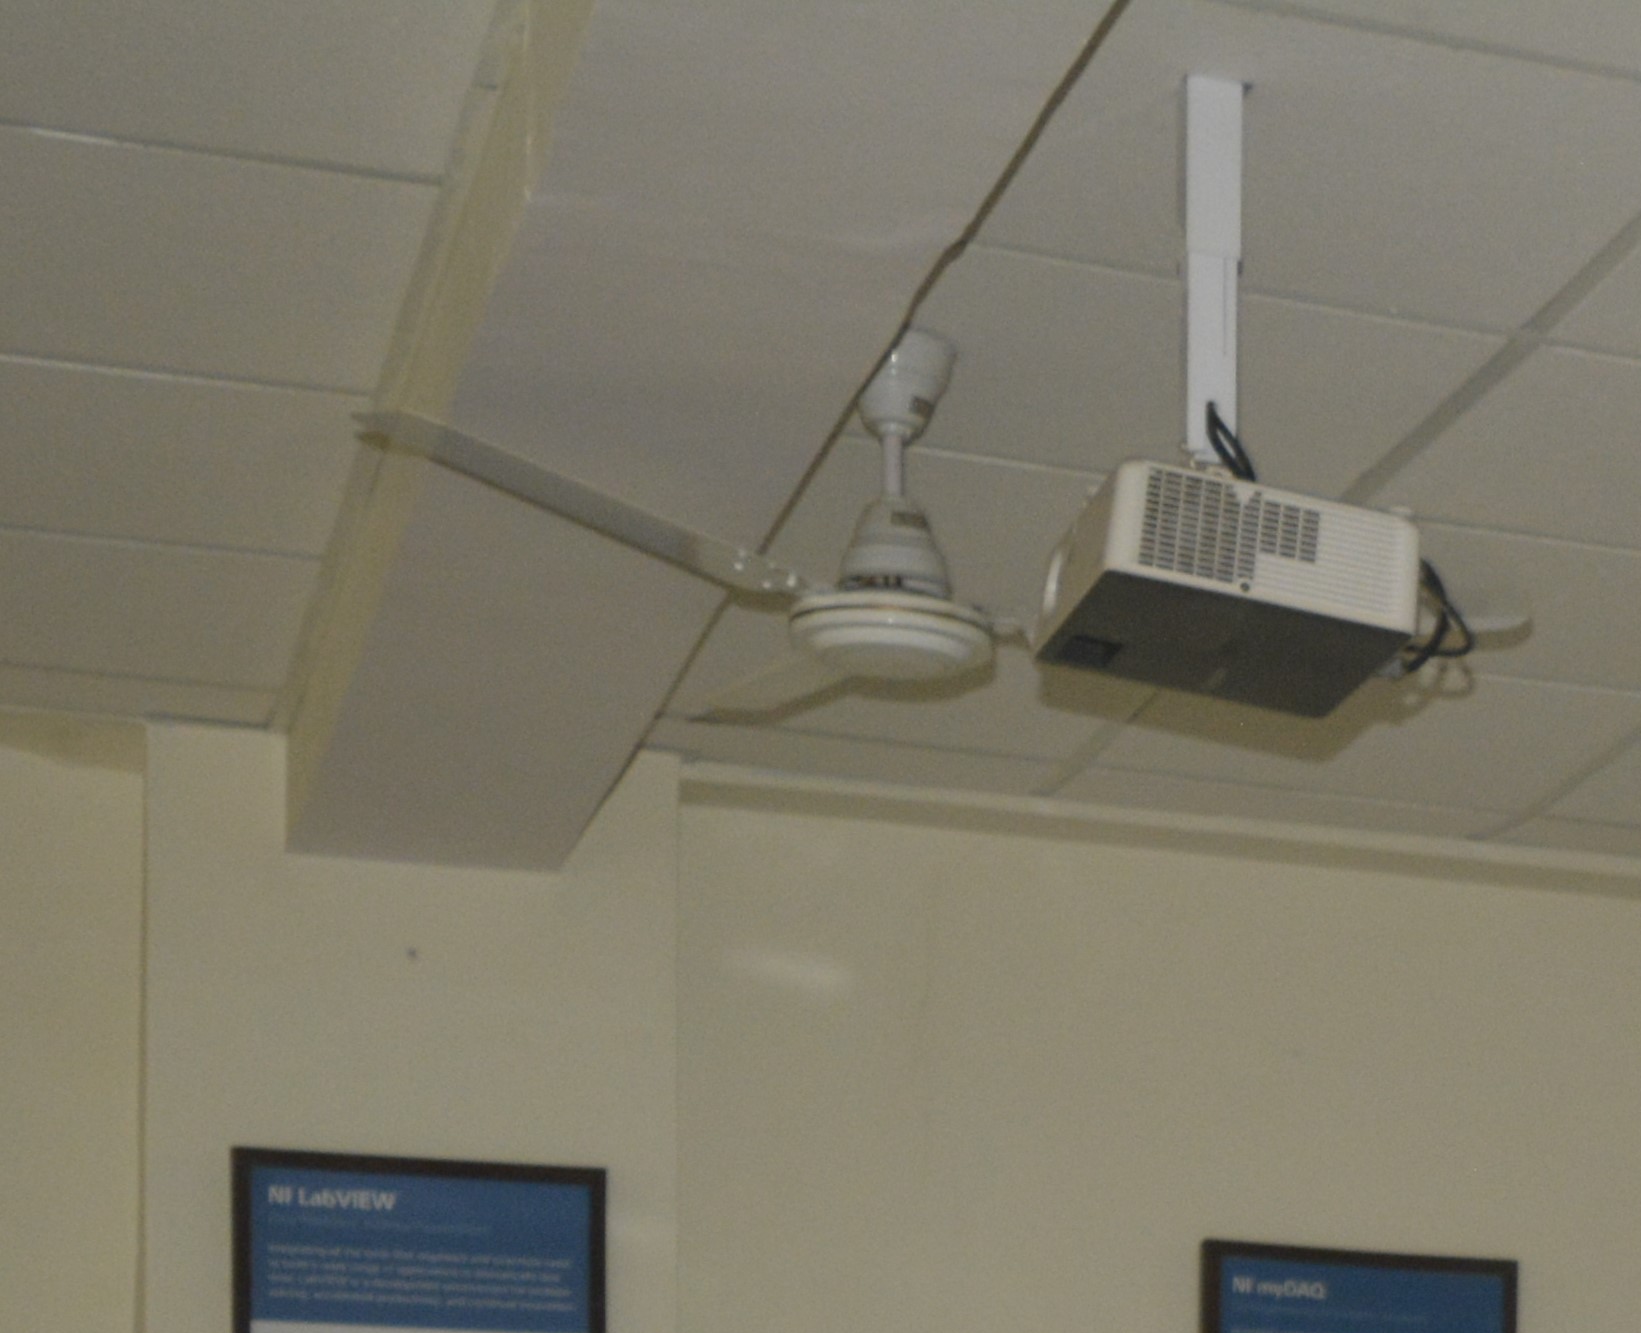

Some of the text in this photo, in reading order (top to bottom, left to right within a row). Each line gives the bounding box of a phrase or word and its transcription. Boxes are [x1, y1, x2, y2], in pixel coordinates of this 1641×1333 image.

[267, 1185, 397, 1211] NI LabVIEW
[1257, 1279, 1327, 1300] myDAQ
